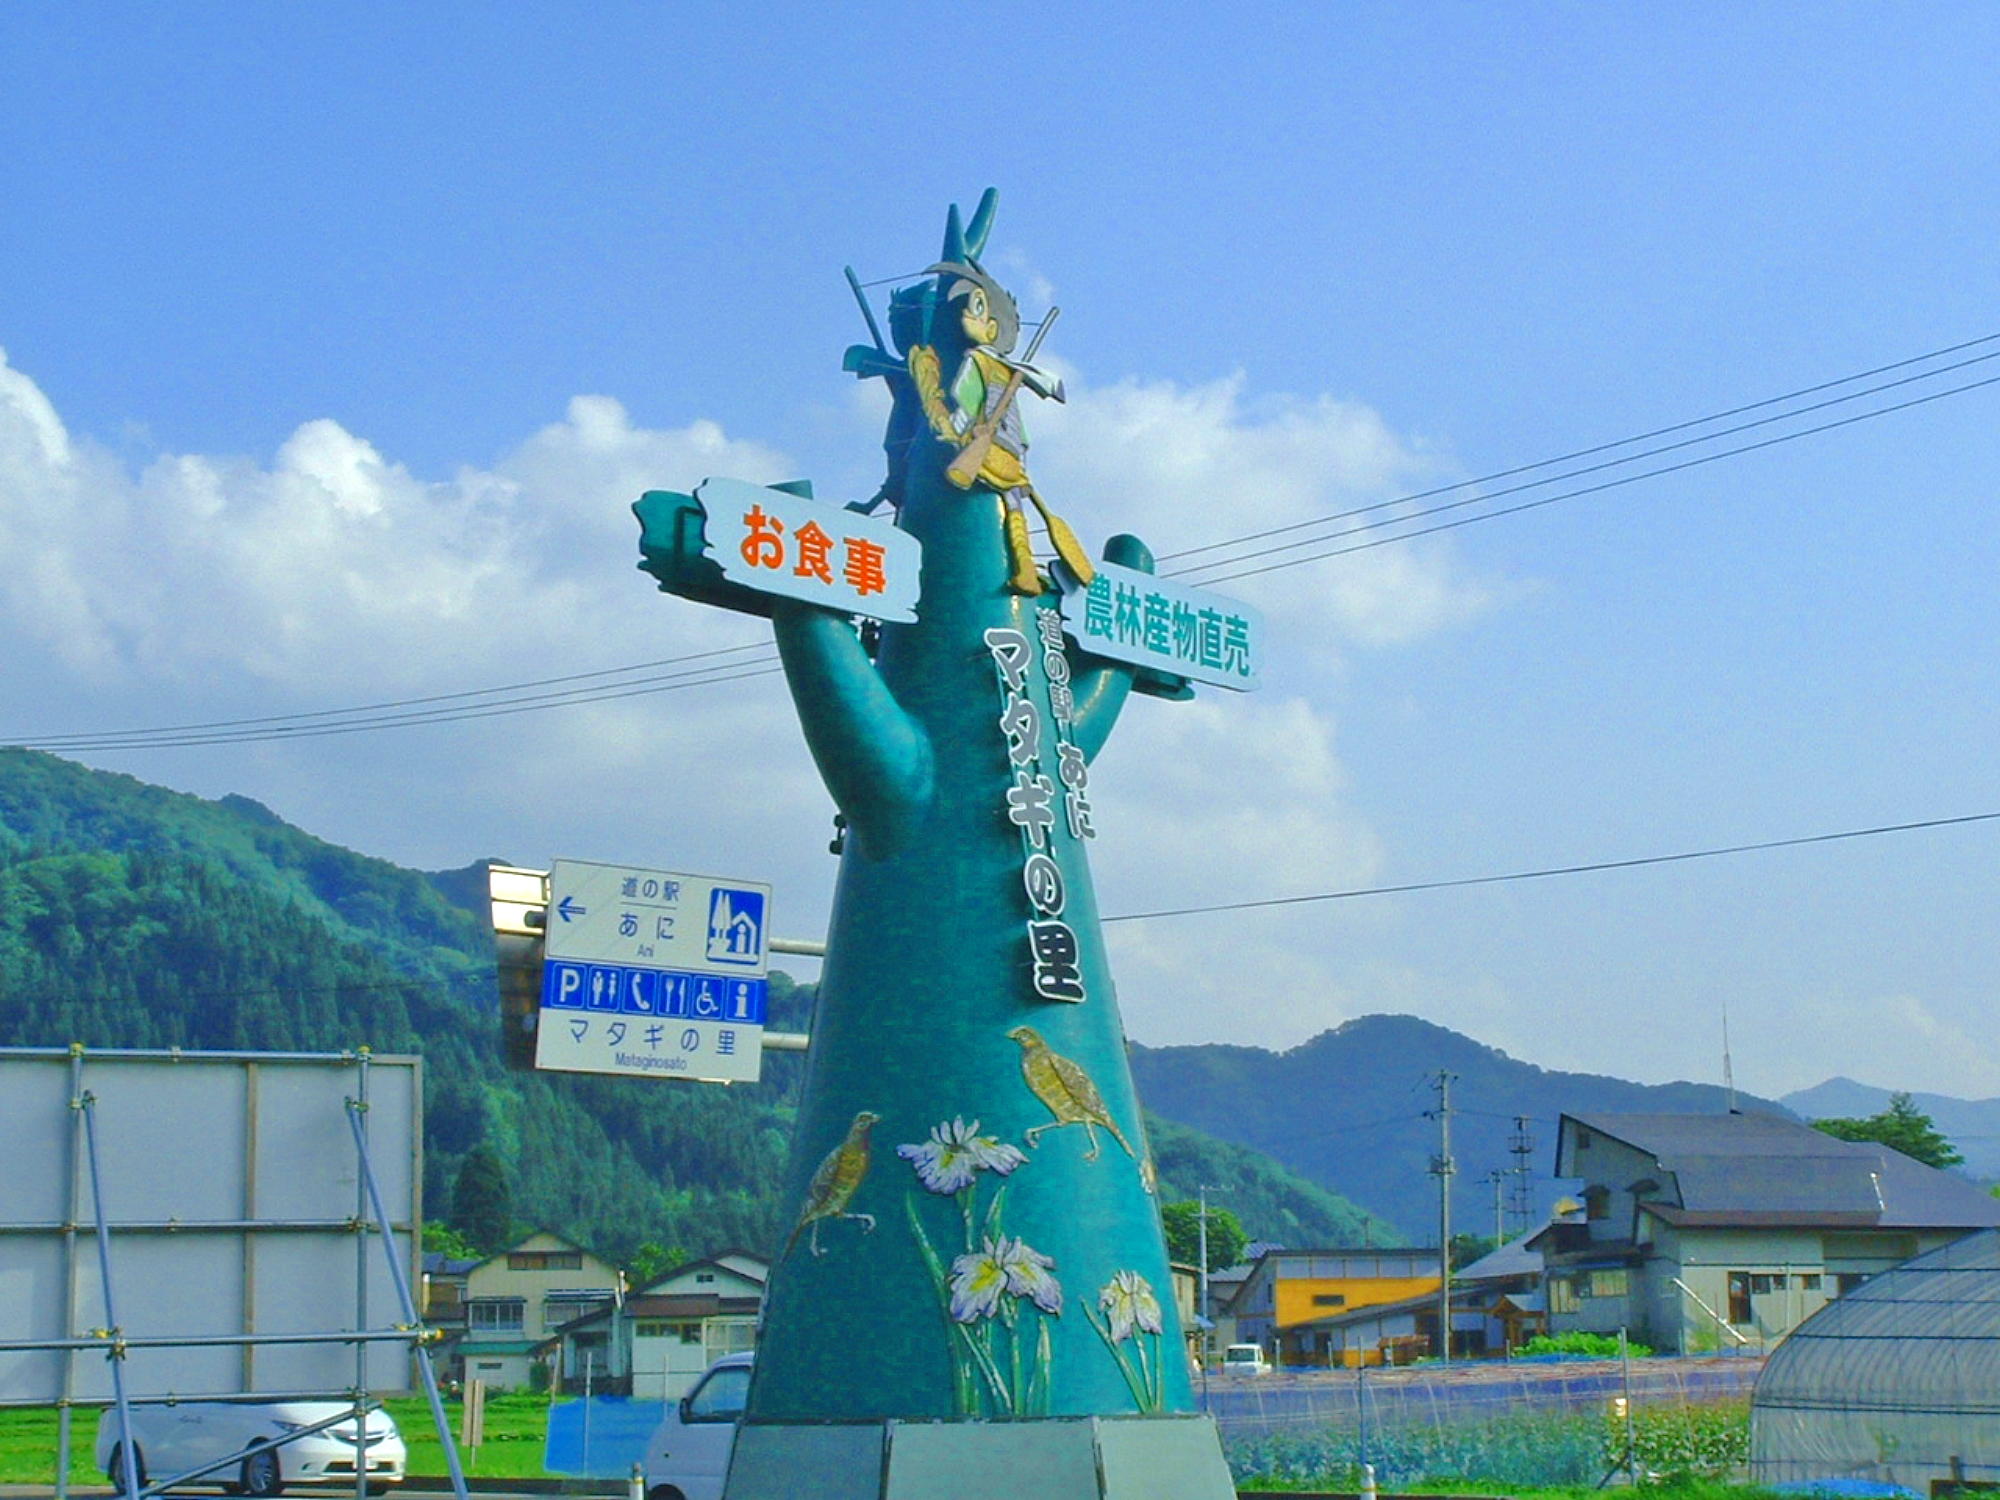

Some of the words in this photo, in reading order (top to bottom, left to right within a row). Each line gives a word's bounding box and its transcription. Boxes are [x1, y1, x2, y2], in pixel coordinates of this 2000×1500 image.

[741, 504, 886, 596] お食事
[1084, 573, 1249, 677] 農林産物直売
[984, 627, 1086, 1003] マタギの里
[620, 877, 680, 902] 道の駅
[618, 913, 675, 940] あに
[637, 944, 655, 958] Ani
[568, 1019, 736, 1056] マタギの里
[615, 1052, 688, 1070] Mataginosato
